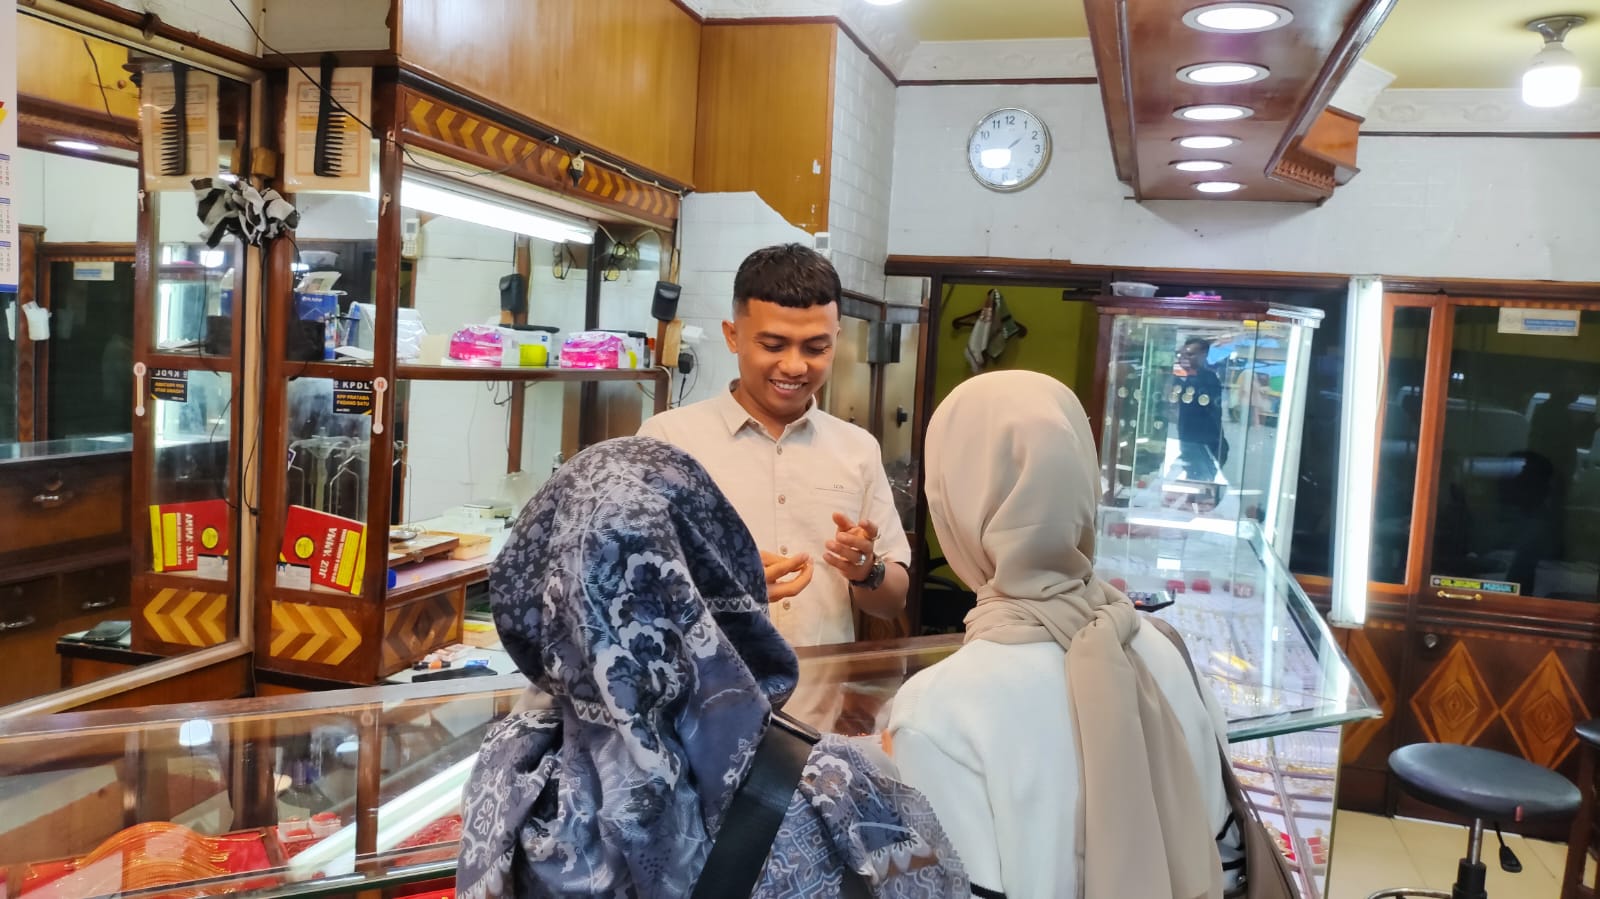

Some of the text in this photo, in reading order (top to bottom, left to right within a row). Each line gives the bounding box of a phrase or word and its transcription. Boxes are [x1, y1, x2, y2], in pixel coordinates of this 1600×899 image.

[993, 120, 1000, 128] 11
[1006, 115, 1015, 125] 12
[981, 131, 990, 140] 10
[1032, 131, 1038, 140] 2
[1034, 144, 1040, 153] 3
[1016, 168, 1023, 178] 5
[342, 381, 370, 389] KPDL
[319, 560, 329, 579] JUZ
